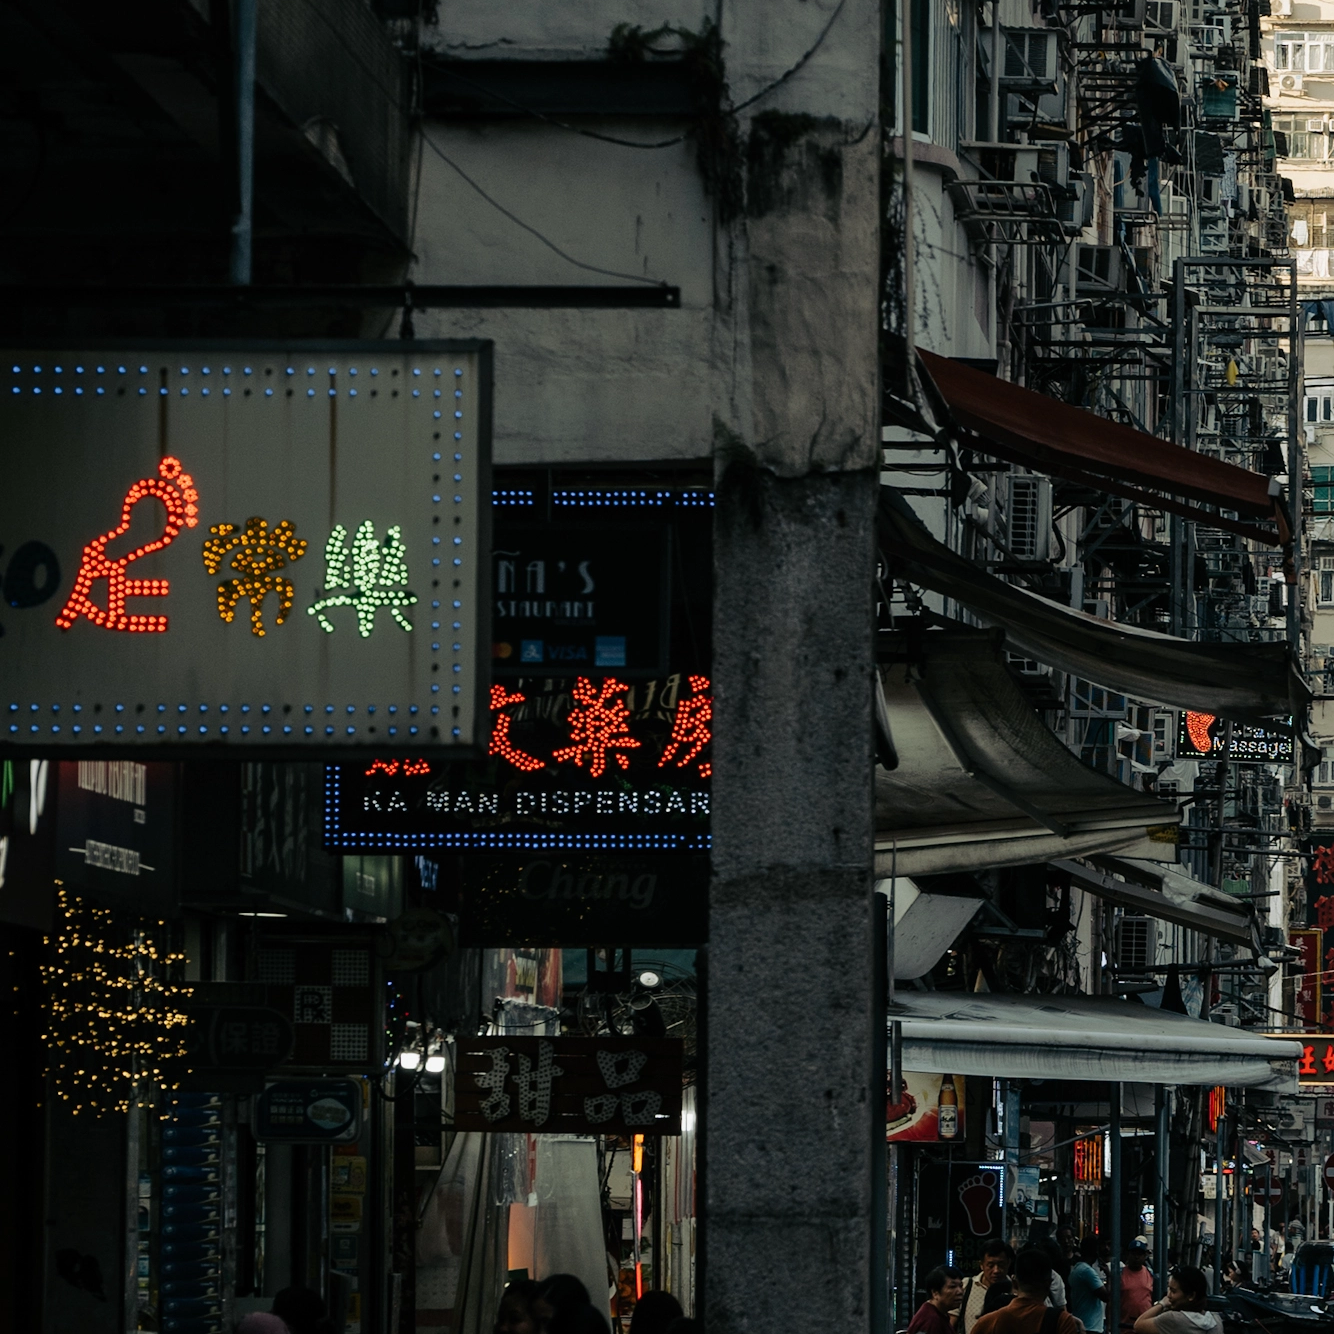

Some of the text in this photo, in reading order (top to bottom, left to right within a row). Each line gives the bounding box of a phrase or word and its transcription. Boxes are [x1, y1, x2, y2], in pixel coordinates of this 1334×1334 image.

[547, 645, 588, 660] VISA
[363, 790, 408, 812] KA
[426, 790, 498, 814] MAN
[521, 859, 659, 909] Chang
[474, 1039, 664, 1127] 甜品
